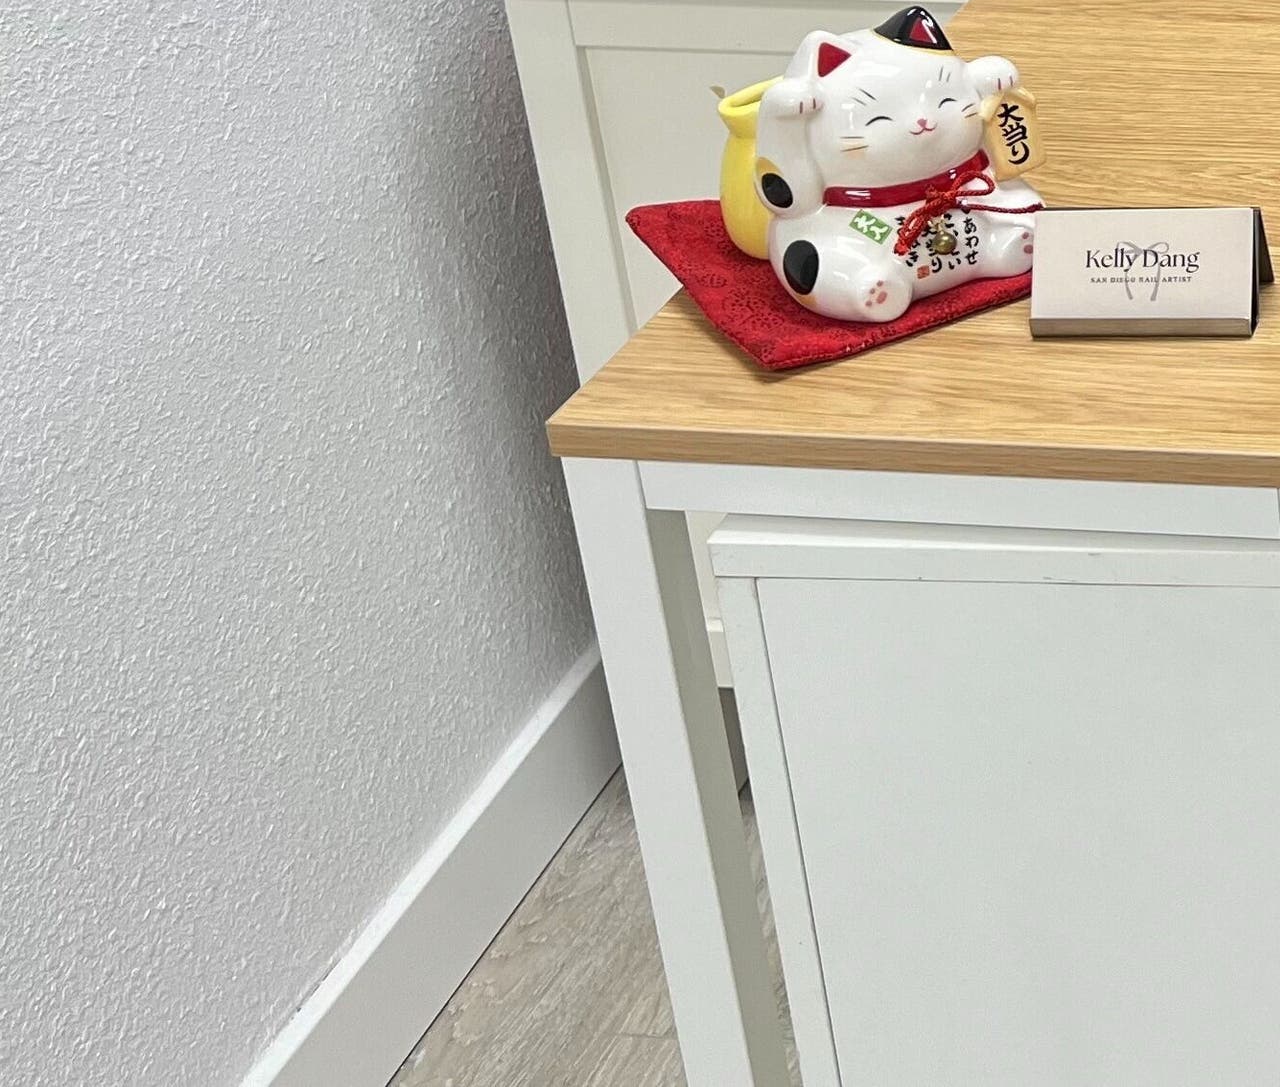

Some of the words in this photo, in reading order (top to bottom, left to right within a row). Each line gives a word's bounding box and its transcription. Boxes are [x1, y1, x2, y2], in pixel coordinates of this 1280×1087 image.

[996, 103, 1030, 165] 大当り
[1085, 247, 1138, 273] Kelly
[1142, 249, 1201, 274] Dang
[1090, 276, 1107, 284] SAN
[1110, 276, 1136, 284] DIEGO
[1138, 276, 1159, 284] NAIL
